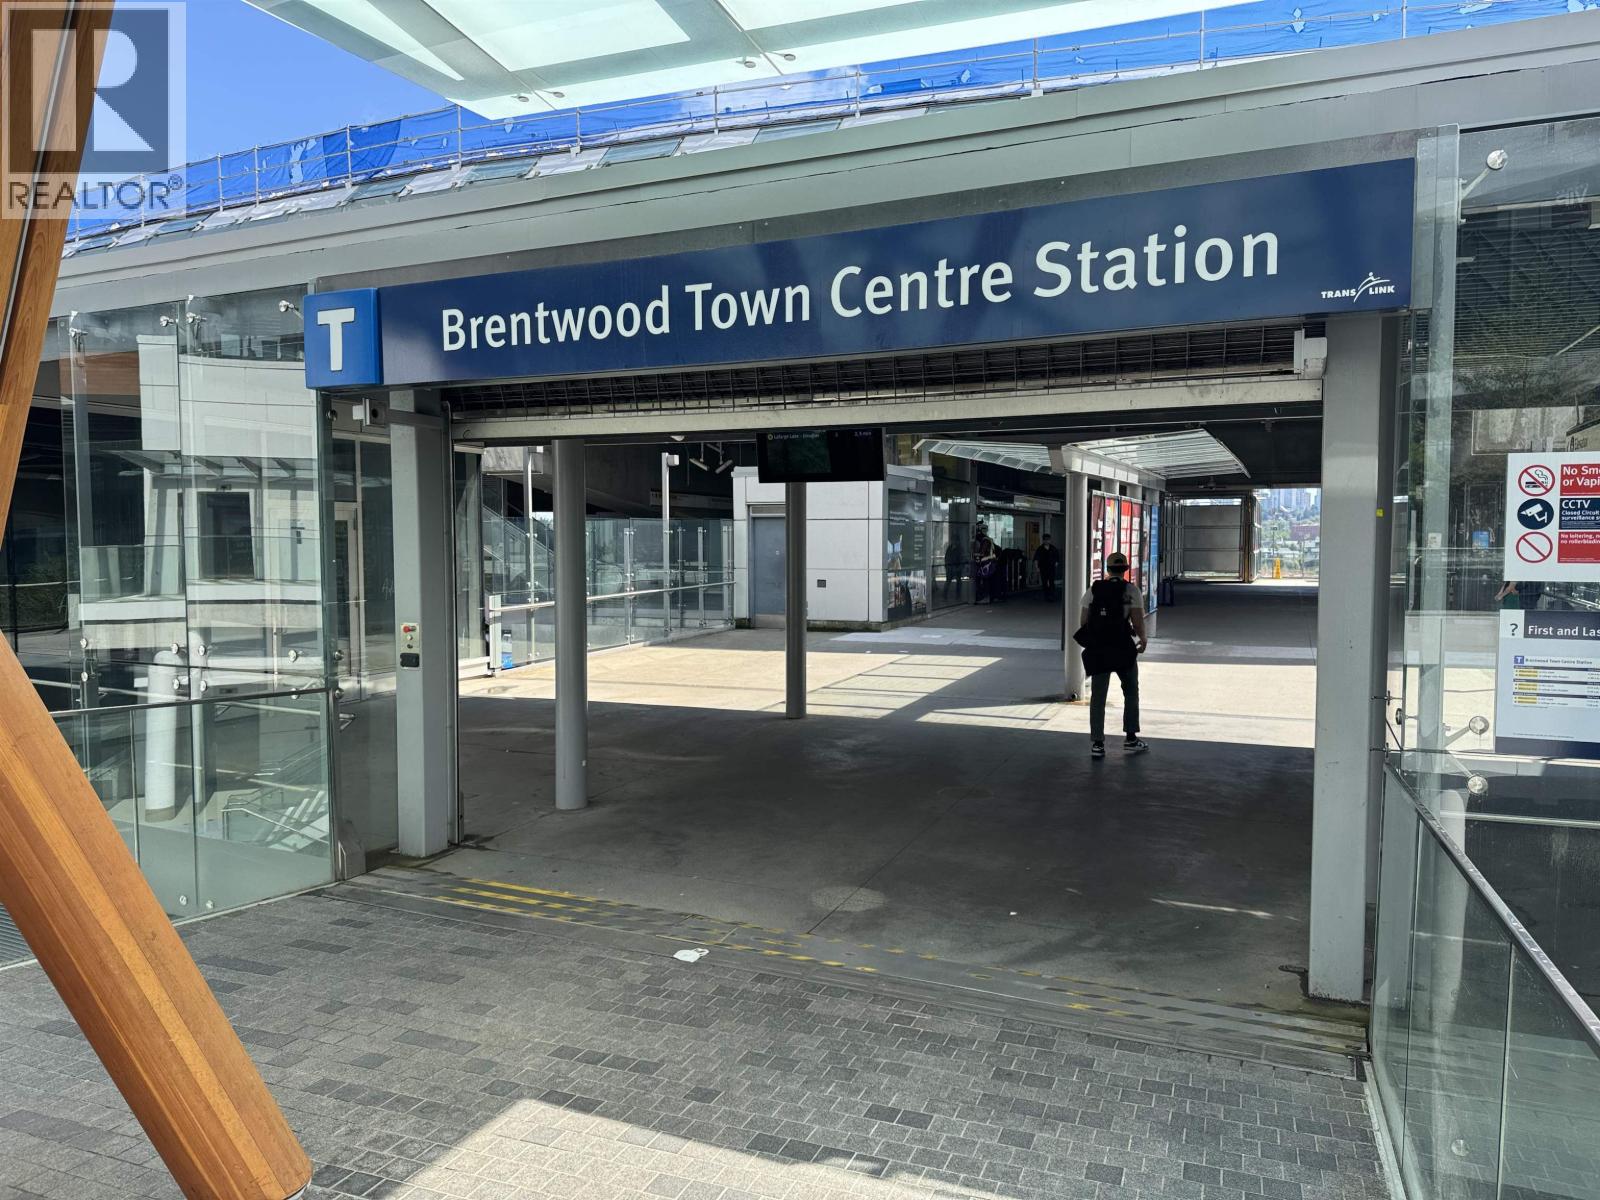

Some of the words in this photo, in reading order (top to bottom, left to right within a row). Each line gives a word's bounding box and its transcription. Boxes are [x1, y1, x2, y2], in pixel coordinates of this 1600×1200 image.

[442, 285, 670, 351] Brentwood
[685, 281, 810, 331] Town
[831, 258, 1013, 318] Centre
[1033, 224, 1278, 298] Station
[317, 308, 355, 371] T
[1563, 466, 1578, 475] No
[1581, 465, 1600, 475] Sm
[1562, 478, 1574, 487] or
[1576, 476, 1600, 488] Vapi
[1562, 499, 1591, 509] CCTV
[1528, 625, 1553, 635] First
[1557, 626, 1579, 636] and
